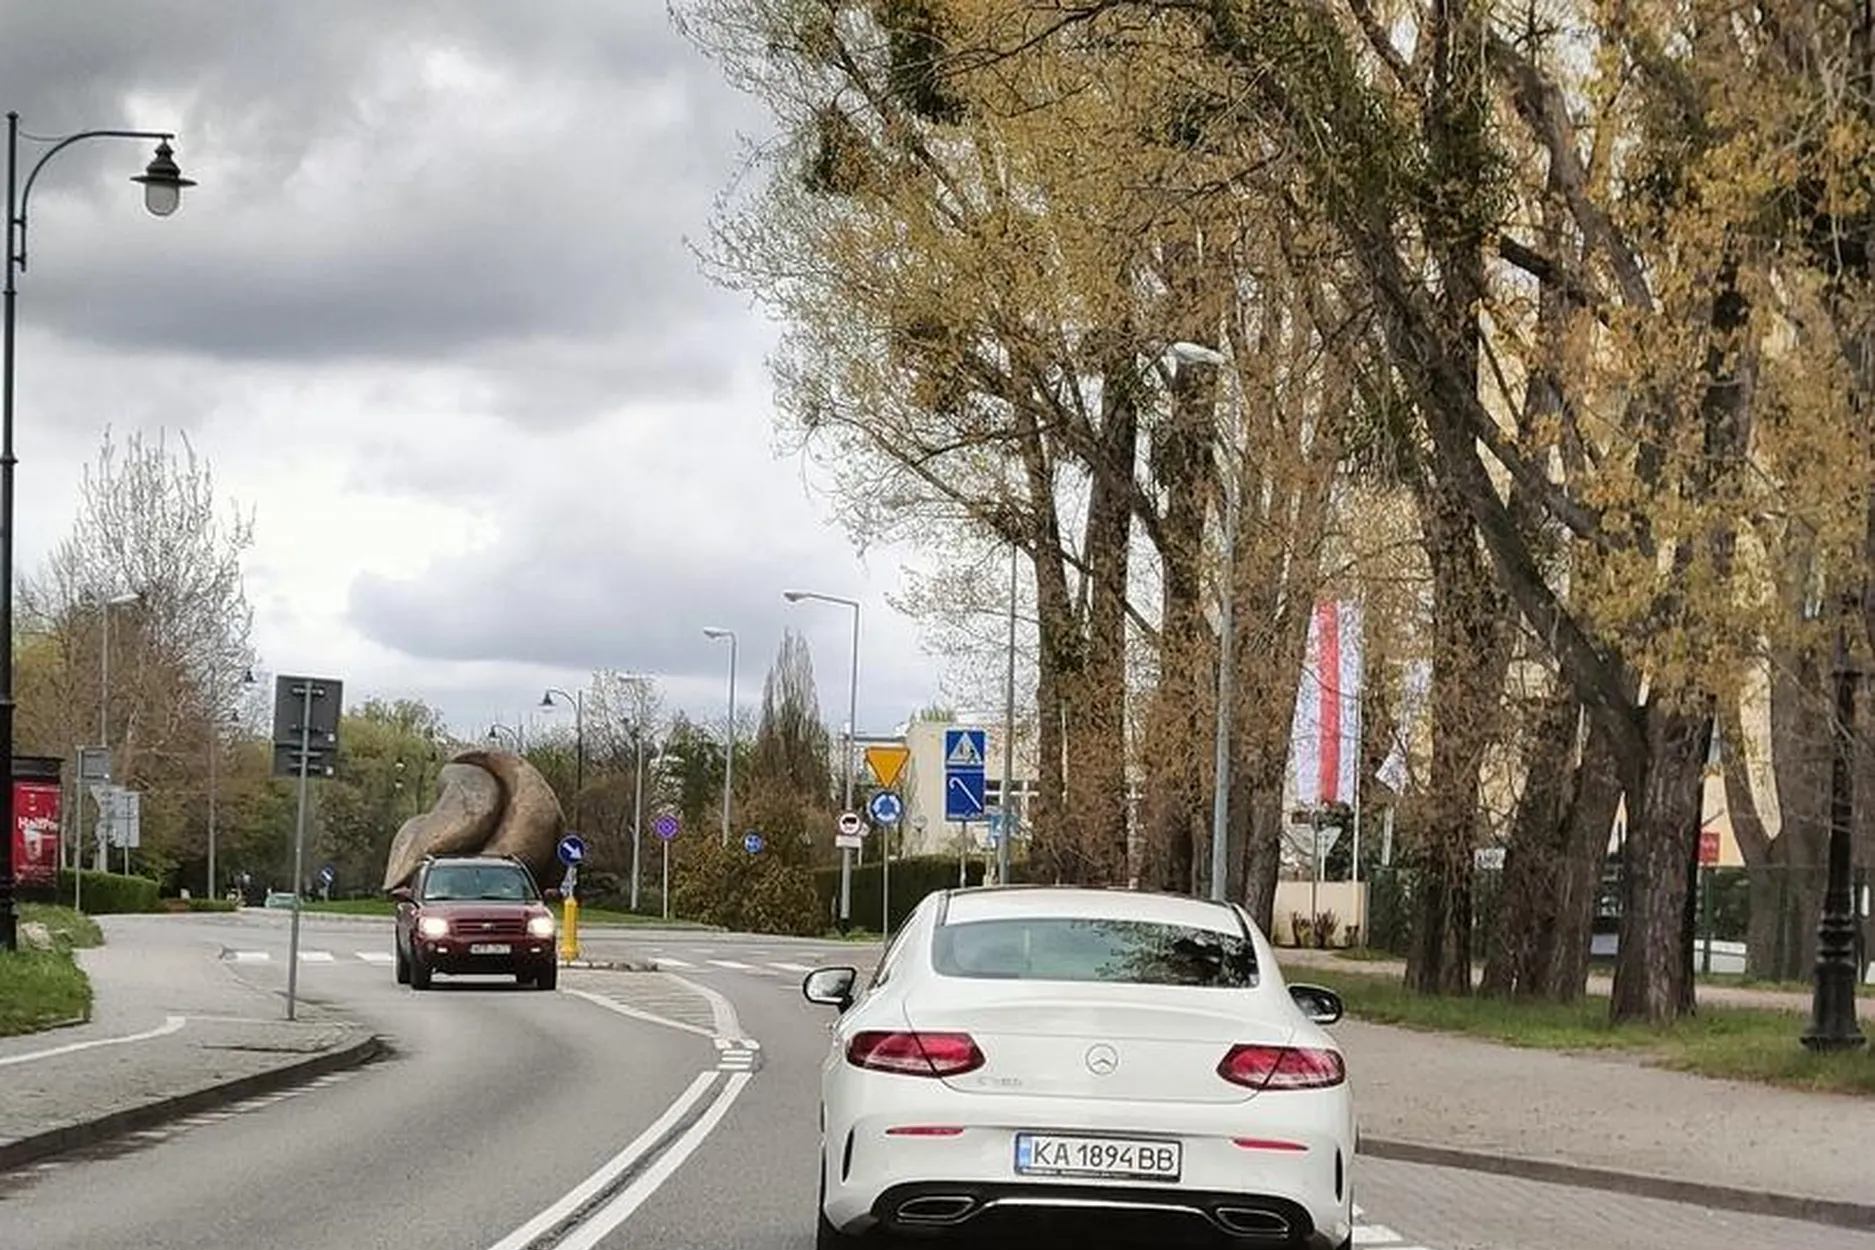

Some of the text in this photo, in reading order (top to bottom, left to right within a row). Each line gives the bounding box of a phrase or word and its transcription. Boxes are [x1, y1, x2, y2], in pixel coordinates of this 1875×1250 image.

[1033, 1141, 1174, 1172] KA 1894 BB
